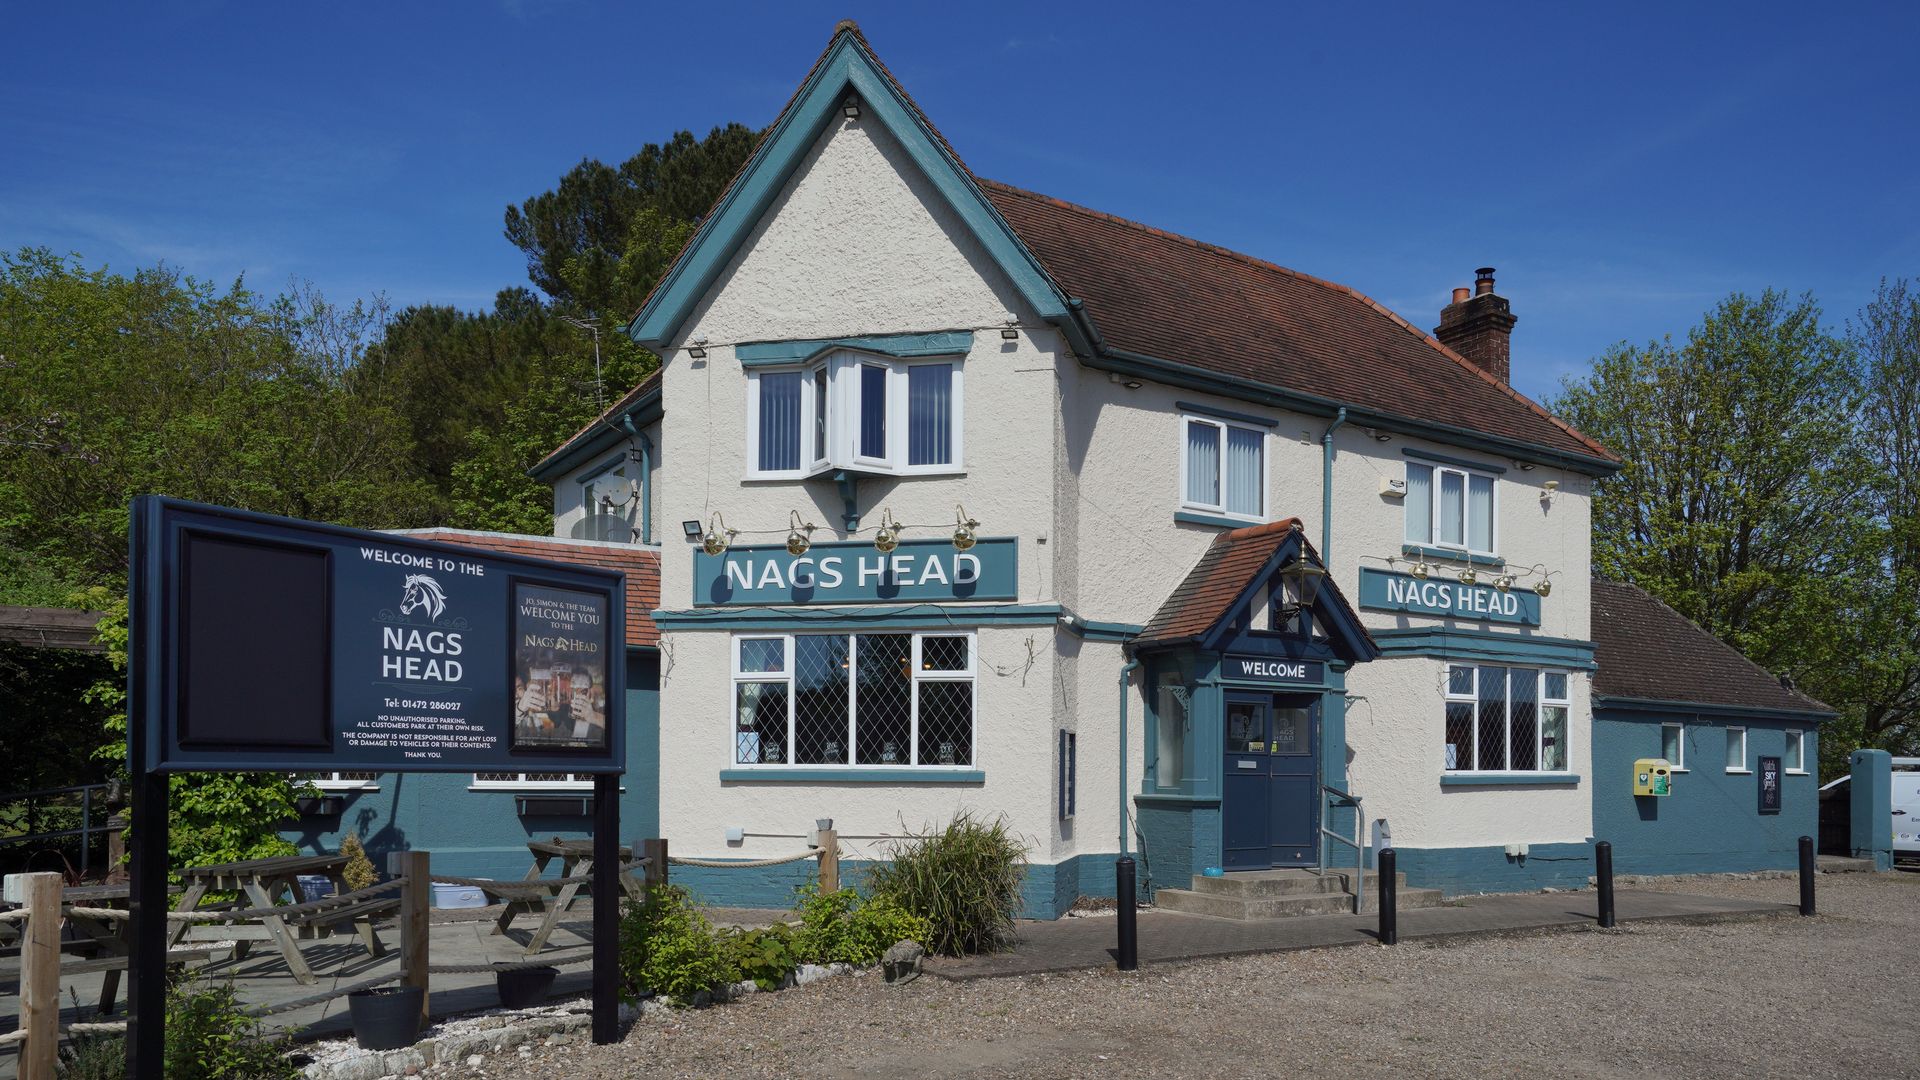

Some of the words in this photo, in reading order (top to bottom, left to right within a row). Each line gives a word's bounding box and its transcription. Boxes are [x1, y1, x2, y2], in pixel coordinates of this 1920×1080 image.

[360, 547, 433, 570] WELCOME
[438, 558, 455, 572] TO
[459, 562, 484, 576] THE
[727, 557, 843, 590] NAGS
[858, 554, 982, 587] HEAD
[537, 600, 558, 608] SIMON
[580, 604, 596, 613] TEAM
[1387, 578, 1451, 608] NAGS
[1458, 588, 1518, 616] HEAD
[520, 606, 576, 622] WELCOME
[578, 612, 600, 625] YOU
[383, 626, 462, 656] NAGS
[382, 655, 462, 682] HEAD
[1242, 661, 1306, 678] WELCOME
[384, 698, 400, 708] Tel:
[402, 700, 427, 709] 01472
[430, 701, 462, 710] 286027
[1764, 771, 1776, 780] SKY
